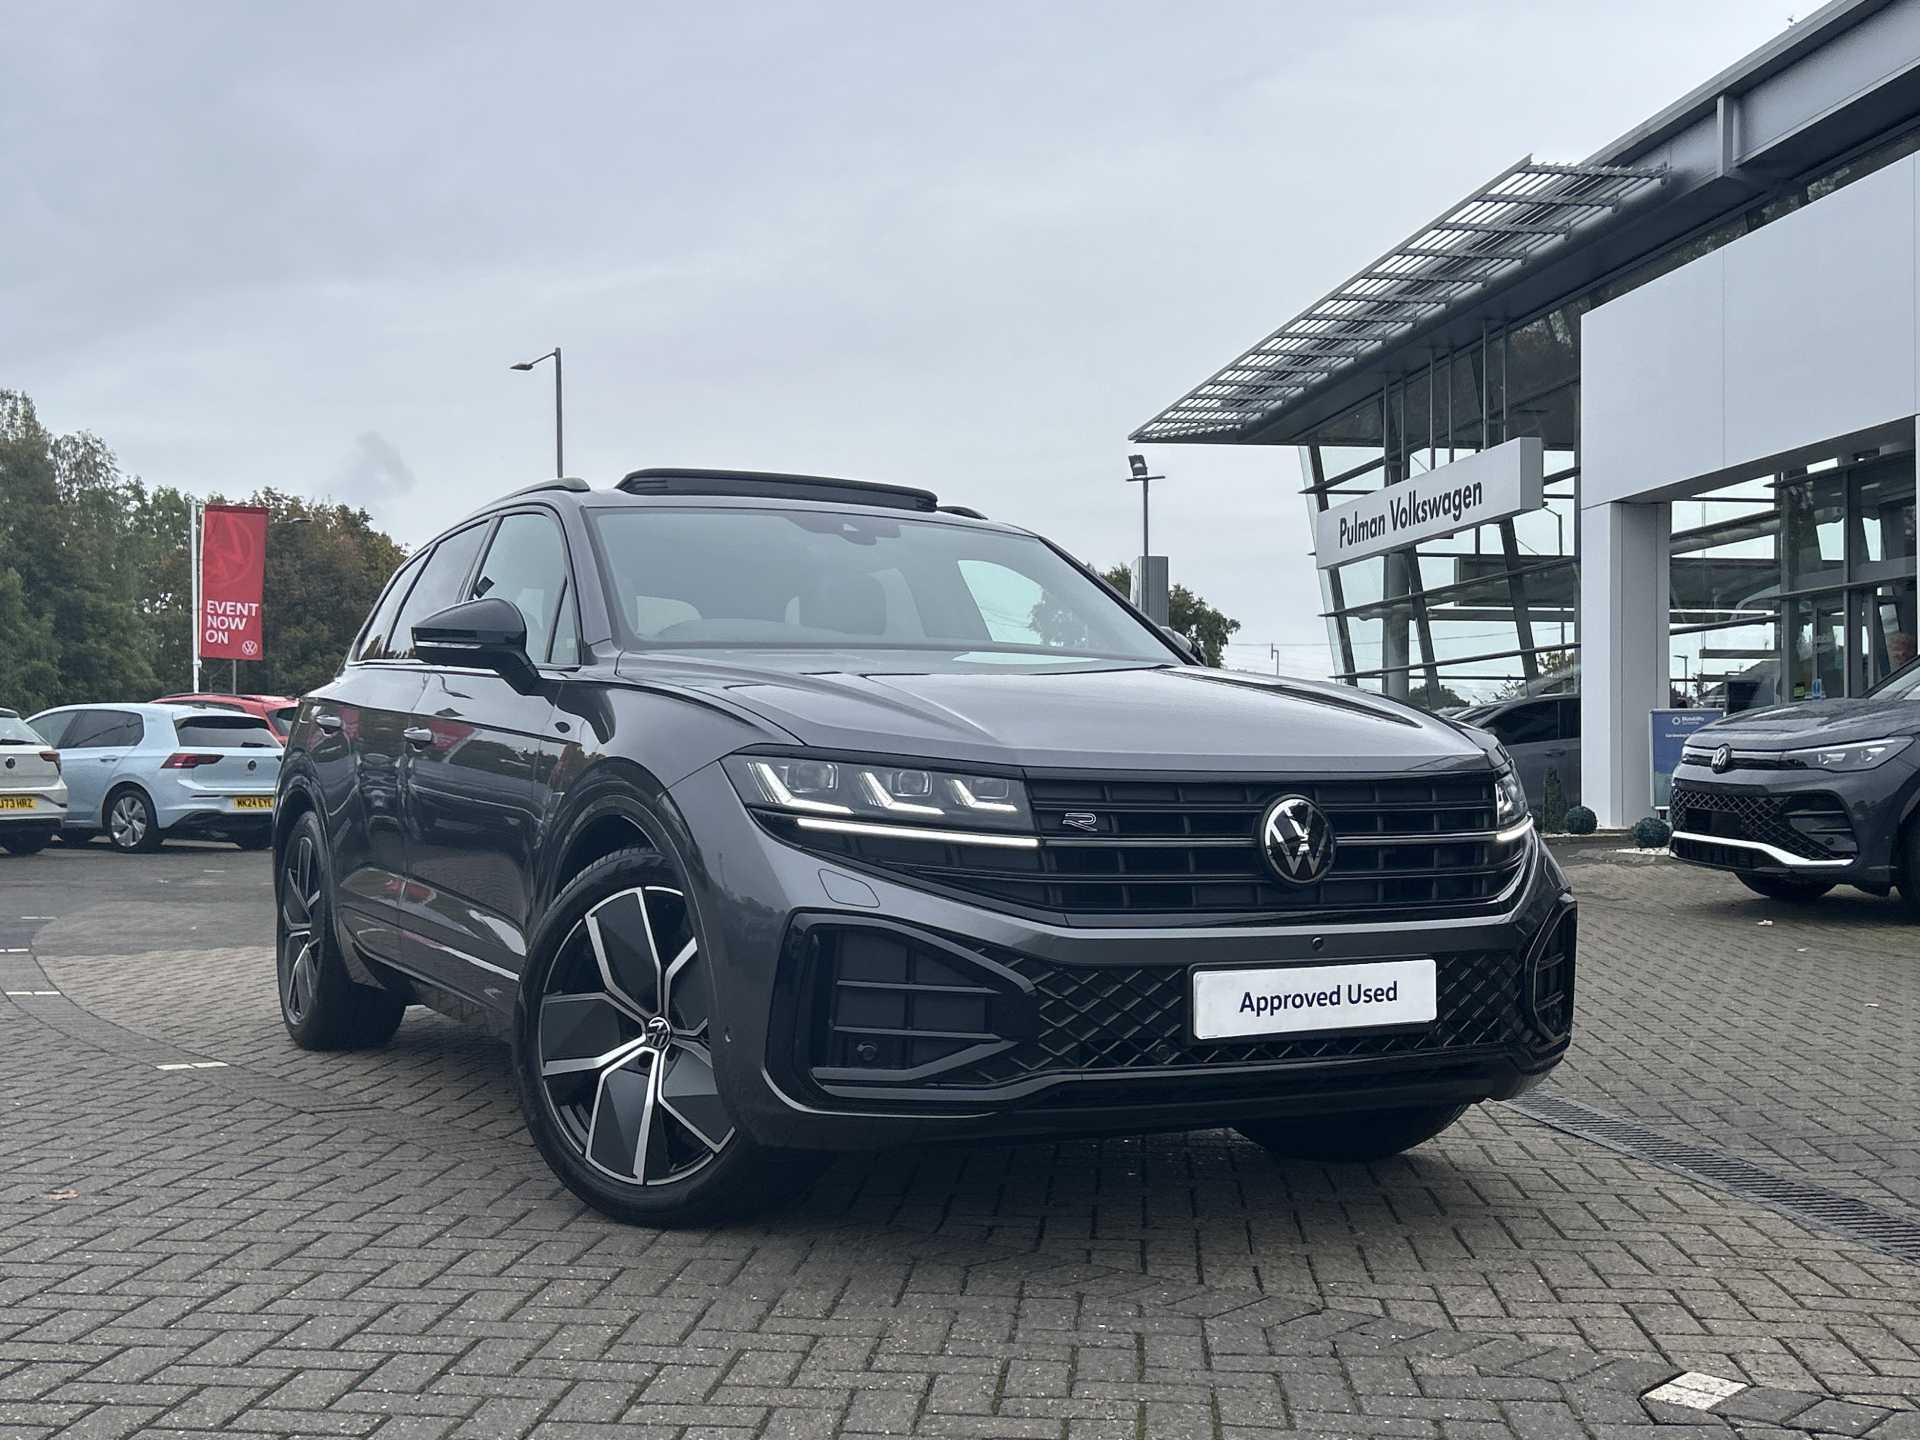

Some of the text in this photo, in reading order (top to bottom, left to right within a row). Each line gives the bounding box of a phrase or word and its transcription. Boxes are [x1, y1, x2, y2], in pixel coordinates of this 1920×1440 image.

[1339, 481, 1483, 549] Pulman Volkswagen
[206, 600, 259, 616] EVENT
[207, 615, 247, 631] NOW
[205, 630, 229, 644] ON
[1239, 981, 1398, 1017] Approved Used
